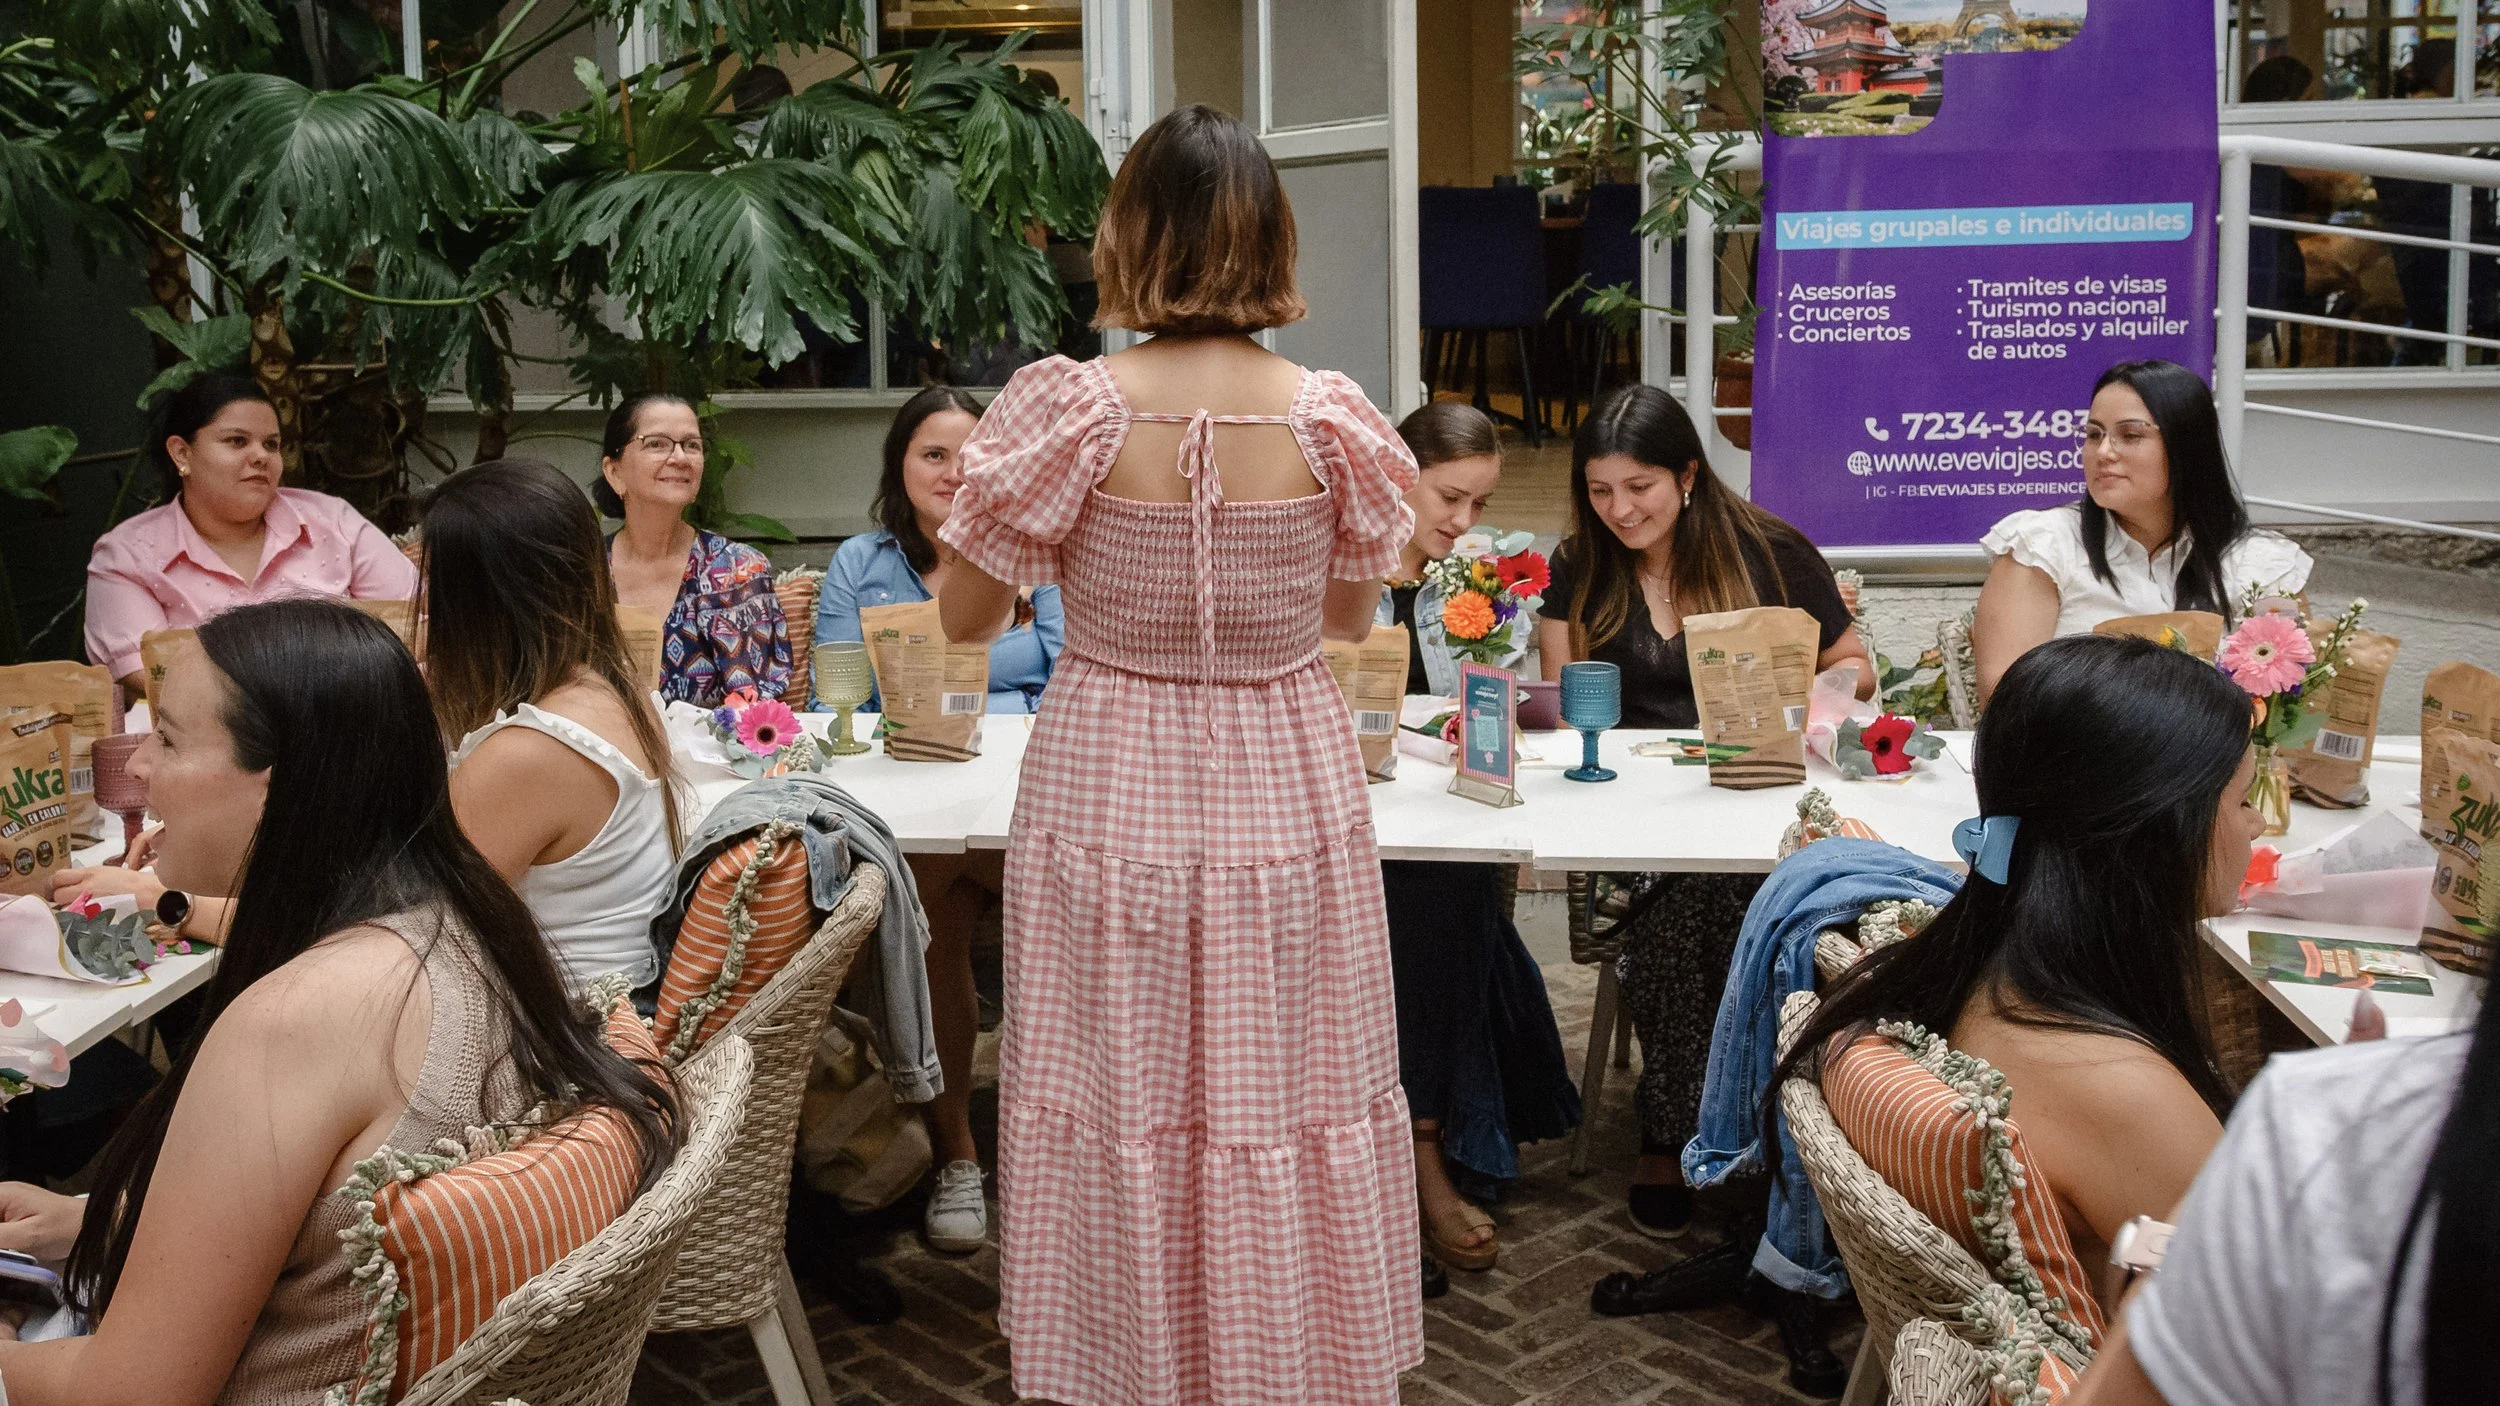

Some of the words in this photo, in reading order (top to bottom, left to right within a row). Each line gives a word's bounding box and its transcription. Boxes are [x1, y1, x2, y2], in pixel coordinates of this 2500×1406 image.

[1782, 216, 1862, 244] Viajes
[1869, 214, 1988, 242] grupales
[1995, 219, 2012, 236] e
[2019, 209, 2186, 234] individuales
[1788, 281, 1896, 301] Asesorías
[1967, 276, 2069, 297] Tramites
[2074, 275, 2104, 295] de
[2109, 274, 2167, 294] visas
[1788, 303, 1890, 322] Cruceros
[1967, 298, 2062, 318] Turismo
[2068, 295, 2166, 316] nacional
[1788, 323, 1911, 343] Conciertos
[1967, 319, 2077, 339] Traslados
[2081, 321, 2096, 341] y
[2101, 316, 2189, 340] alquiler
[1967, 341, 1997, 360] de
[2003, 342, 2067, 359] autos
[1901, 409, 2090, 441] 7234-3483
[1872, 485, 1887, 498] IG
[1998, 481, 2087, 495] EXPERIENCE
